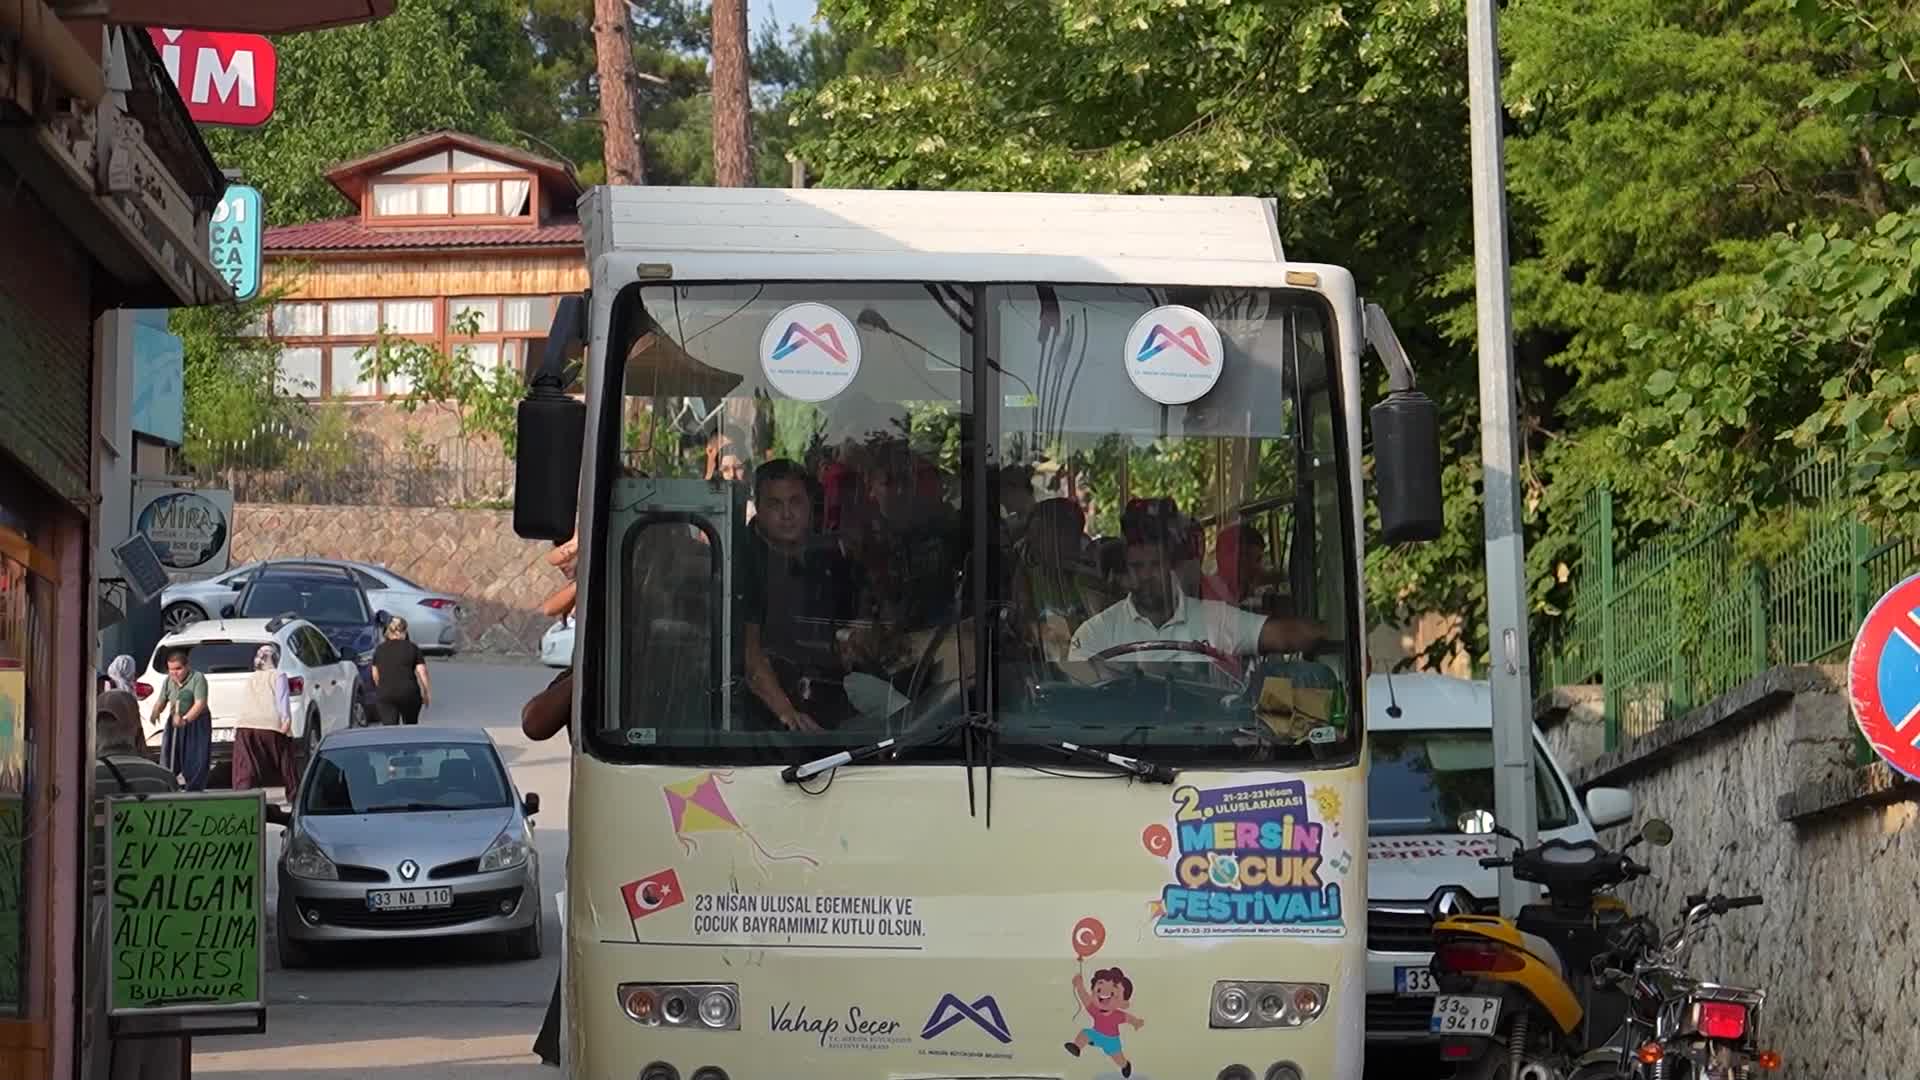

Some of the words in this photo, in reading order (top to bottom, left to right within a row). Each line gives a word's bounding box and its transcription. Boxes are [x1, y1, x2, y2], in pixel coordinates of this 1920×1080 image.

[1215, 795, 1303, 814] ULUSLARARASI
[1223, 790, 1264, 802] 21-22-23
[1265, 787, 1293, 798] Nisan
[117, 842, 158, 868] EV
[171, 841, 253, 870] YAPIMI
[1179, 854, 1321, 889] ÇOCUK
[113, 873, 254, 913] ŞALGAM
[375, 892, 392, 906] 33
[399, 891, 416, 905] NA
[425, 889, 449, 904] 110
[695, 894, 713, 912] 23
[716, 892, 757, 912] NİSAN
[761, 895, 811, 913] ULUSAL
[815, 896, 892, 915] EGEMENLİK
[897, 898, 913, 916] VE
[694, 915, 739, 935] ÇOCUK
[742, 916, 828, 935] BAYRAMIMIZ
[832, 918, 875, 936] KUTLU
[878, 919, 926, 937] OLSUN.
[1408, 970, 1431, 990] 33
[129, 982, 245, 1001] BULUNUR
[1438, 998, 1461, 1013] 33
[1482, 999, 1494, 1014] P
[770, 1001, 839, 1048] Vahap
[844, 1006, 901, 1036] Seçer
[1446, 1015, 1490, 1030] 9410
